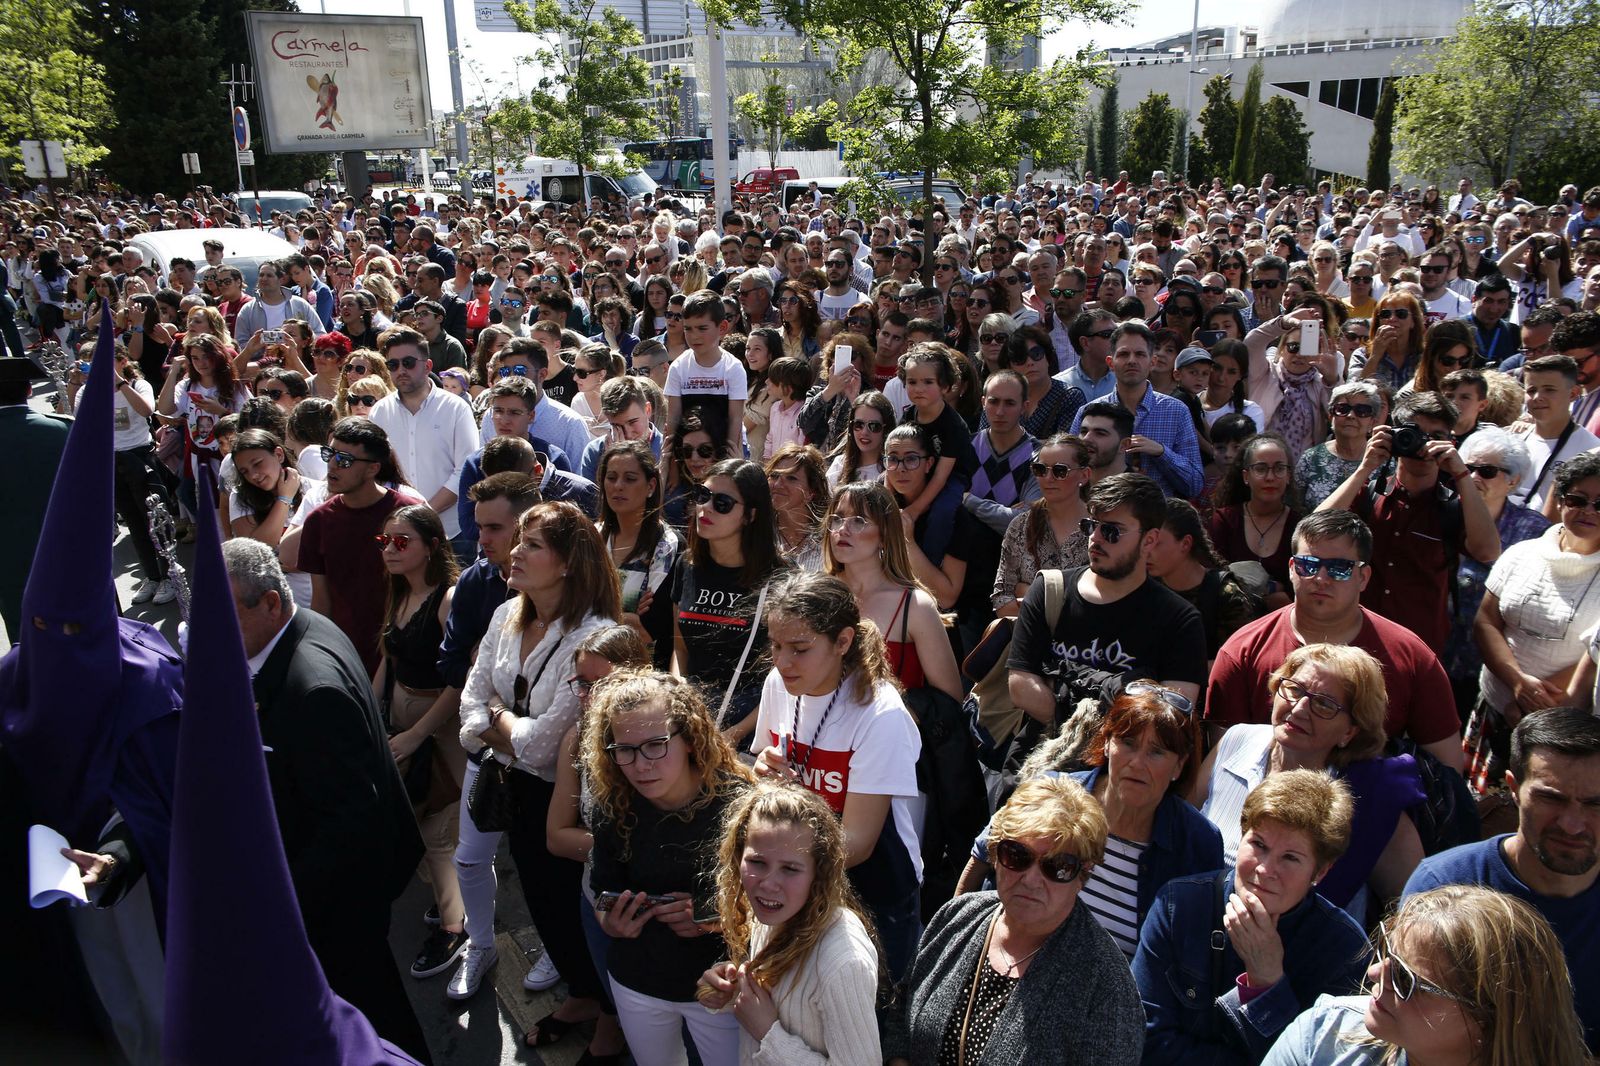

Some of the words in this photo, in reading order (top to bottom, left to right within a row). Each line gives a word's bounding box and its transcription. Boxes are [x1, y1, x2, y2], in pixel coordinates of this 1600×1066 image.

[271, 30, 369, 67] Carmela
[289, 60, 345, 68] RESTAURANTES
[686, 86, 694, 120] CIENCIAS
[297, 134, 323, 142] GRANADA
[341, 132, 365, 140] CARMELA
[695, 588, 743, 609] BOY
[1105, 639, 1137, 670] Oz
[797, 763, 844, 794] VI'S
